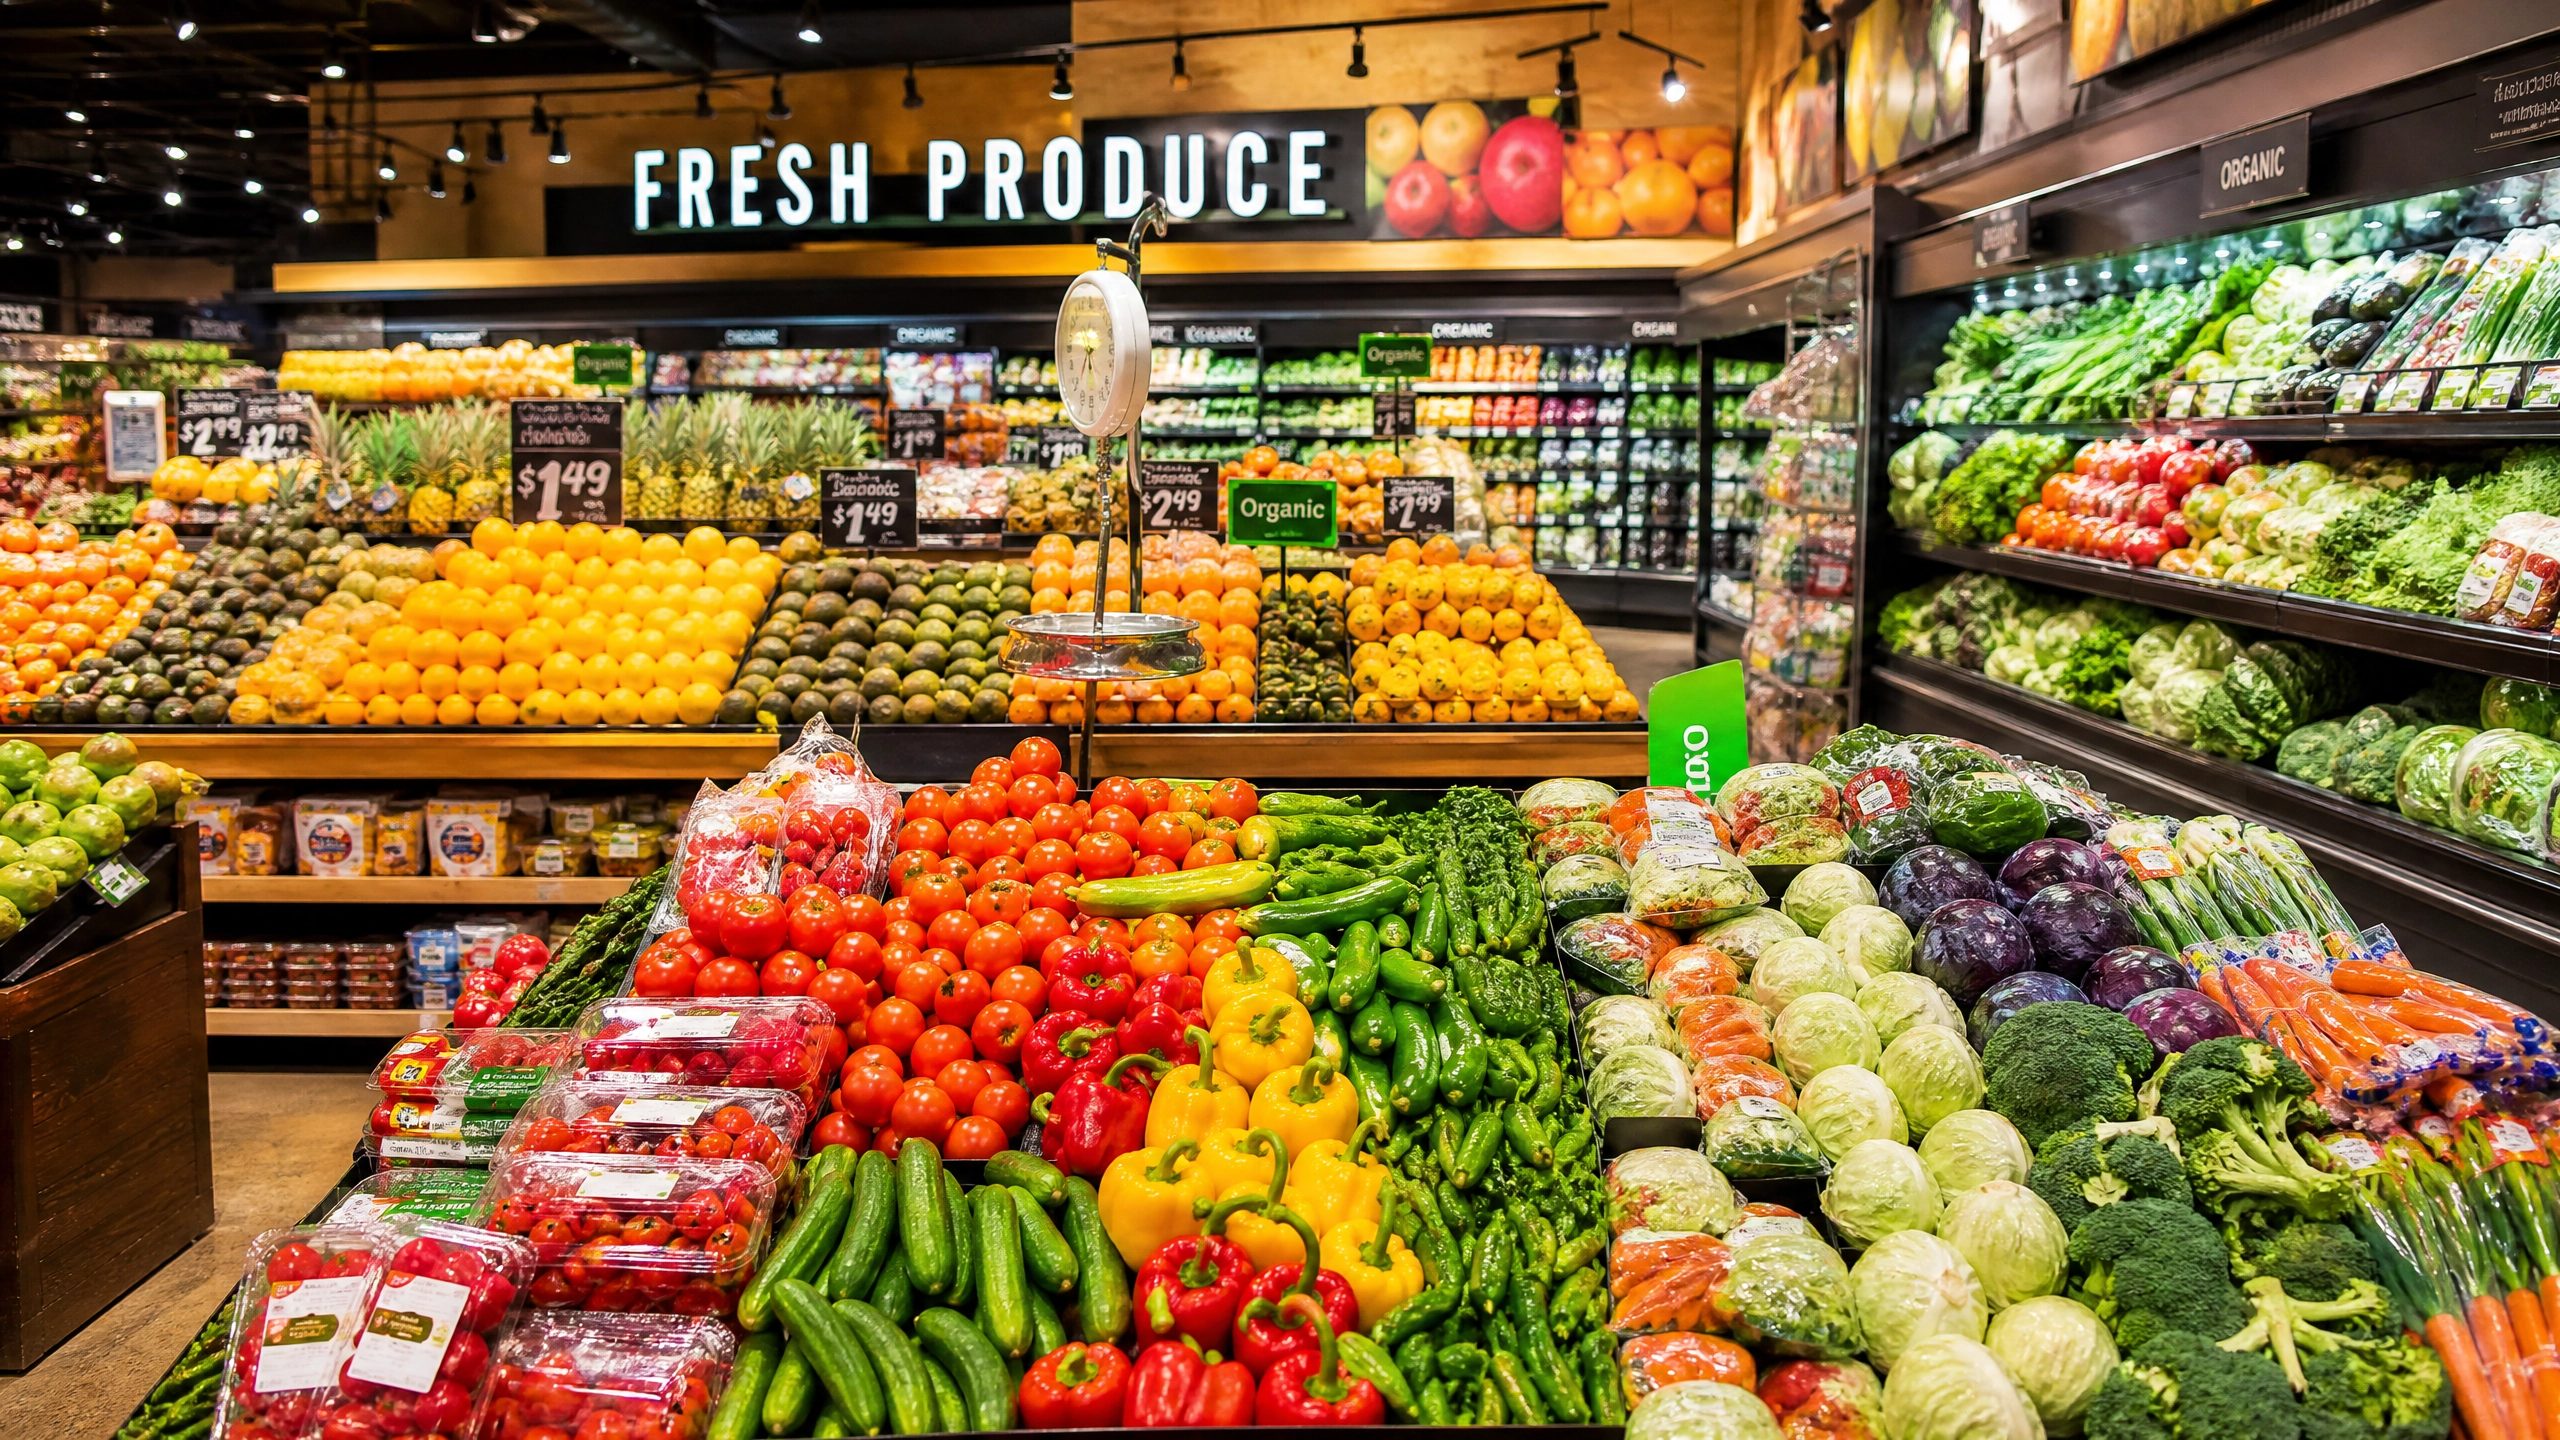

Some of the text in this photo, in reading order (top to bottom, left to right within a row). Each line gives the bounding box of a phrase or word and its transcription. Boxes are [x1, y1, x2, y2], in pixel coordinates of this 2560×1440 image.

[2220, 146, 2285, 190] ORGANIC
[634, 130, 1327, 230] FRESH PRODUCE
[1432, 322, 1493, 338] ORGANIC
[577, 354, 628, 374] Organic
[1367, 346, 1424, 365] Organic
[1240, 497, 1325, 523] Organic
